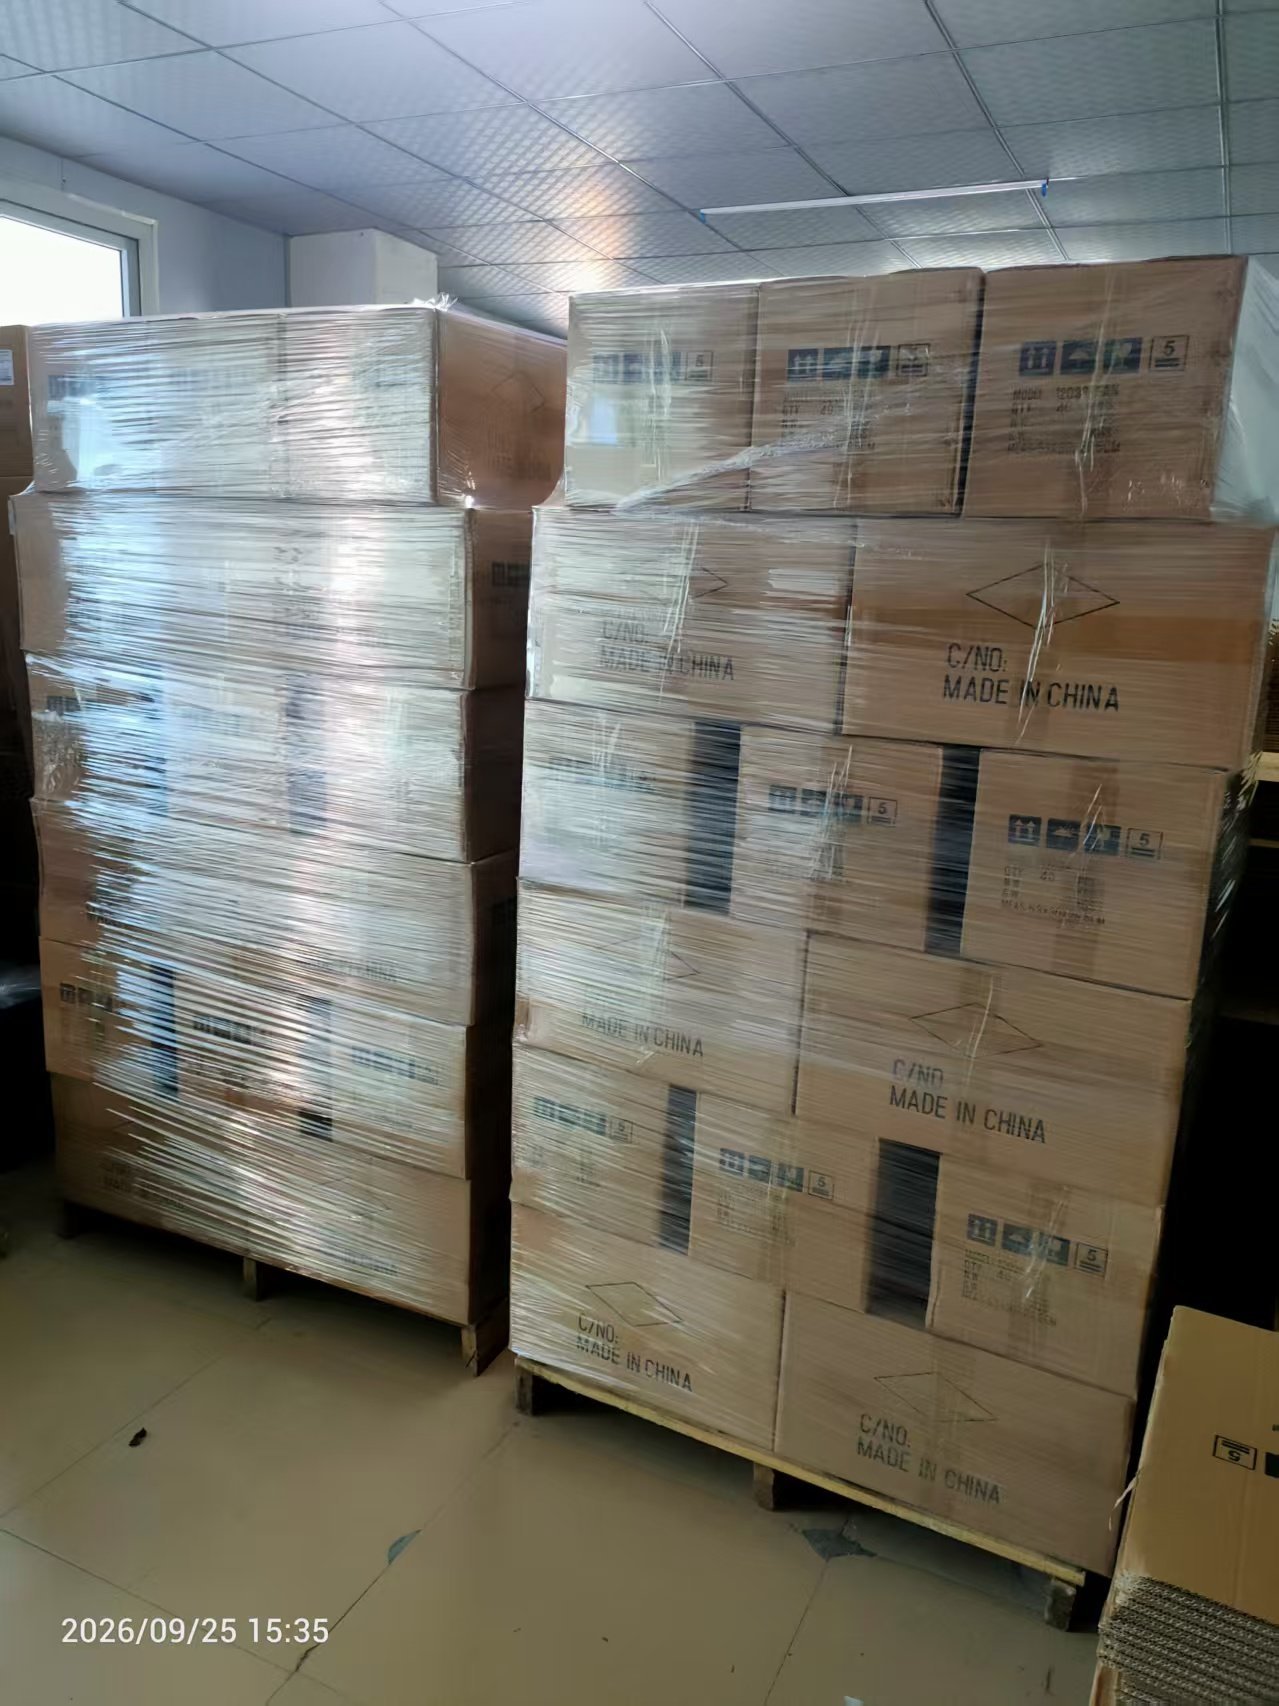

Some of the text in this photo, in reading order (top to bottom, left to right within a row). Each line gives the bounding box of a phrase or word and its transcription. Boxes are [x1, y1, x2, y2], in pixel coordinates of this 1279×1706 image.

[1164, 340, 1175, 357] 5
[677, 655, 735, 681] CHINA
[943, 674, 1120, 712] MADE IN CHINA
[878, 801, 889, 815] 5
[1138, 832, 1151, 848] 5
[582, 1014, 704, 1057] MADE IN CHINA
[889, 1084, 1046, 1144] MADE IN CHINA
[816, 1176, 826, 1188] 5
[1086, 1248, 1098, 1262] 5
[576, 1335, 693, 1392] MADE IN CHINA
[1228, 1450, 1241, 1462] 5
[857, 1436, 1001, 1504] MADE IN CHINA
